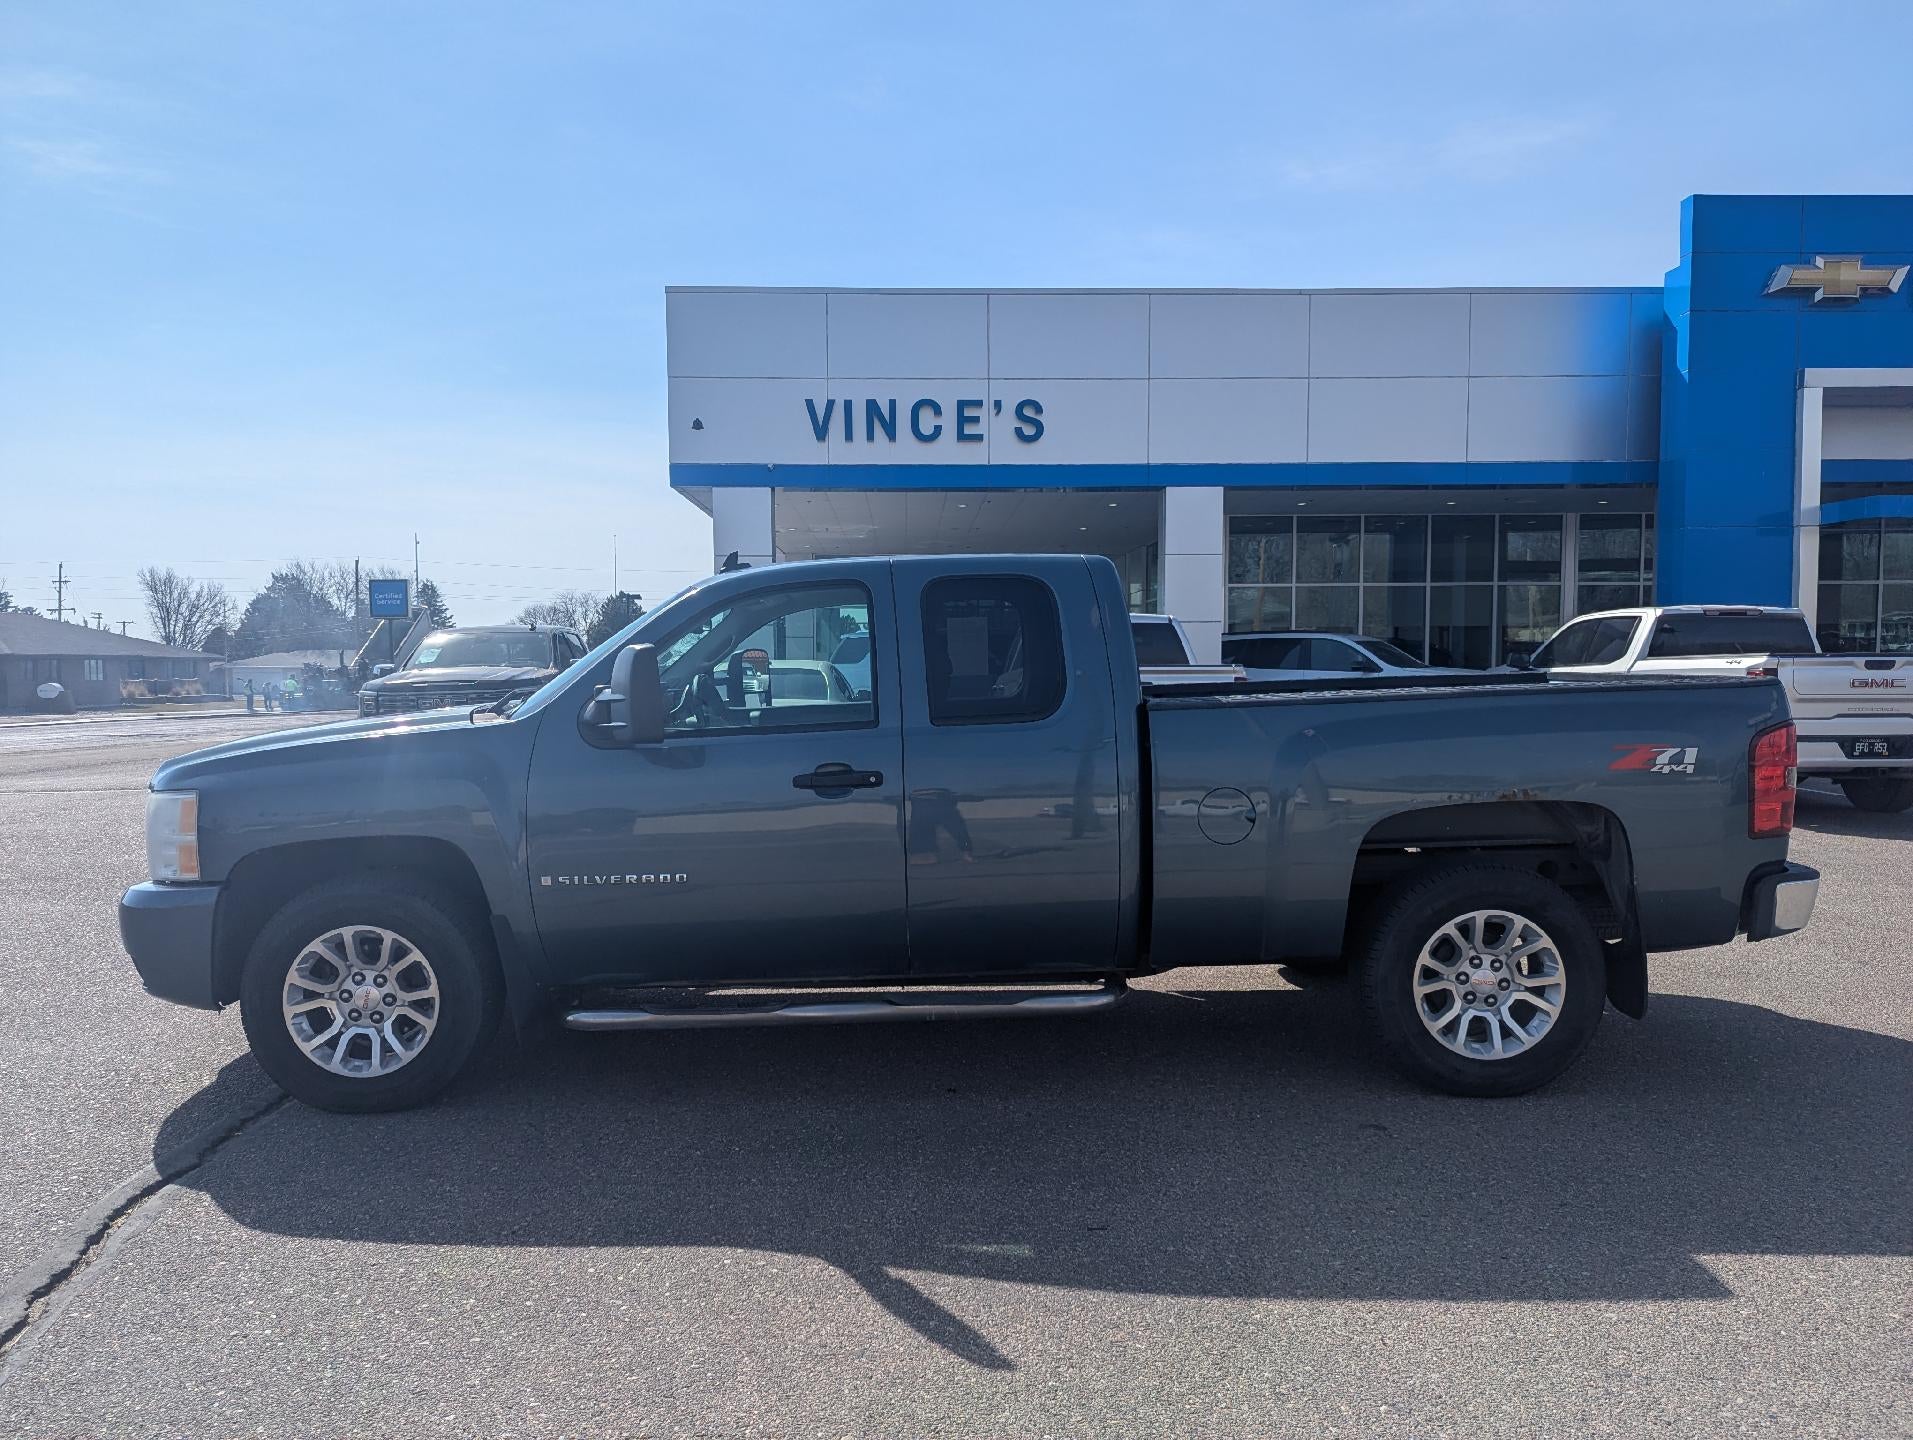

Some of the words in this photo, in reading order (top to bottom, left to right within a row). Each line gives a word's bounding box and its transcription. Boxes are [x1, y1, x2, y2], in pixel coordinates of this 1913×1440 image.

[804, 398, 1045, 443] VINCE'S
[1849, 678, 1907, 689] GMC
[1608, 743, 1699, 771] Z71
[1649, 764, 1695, 774] 4x4
[558, 873, 688, 886] SILVERADO
